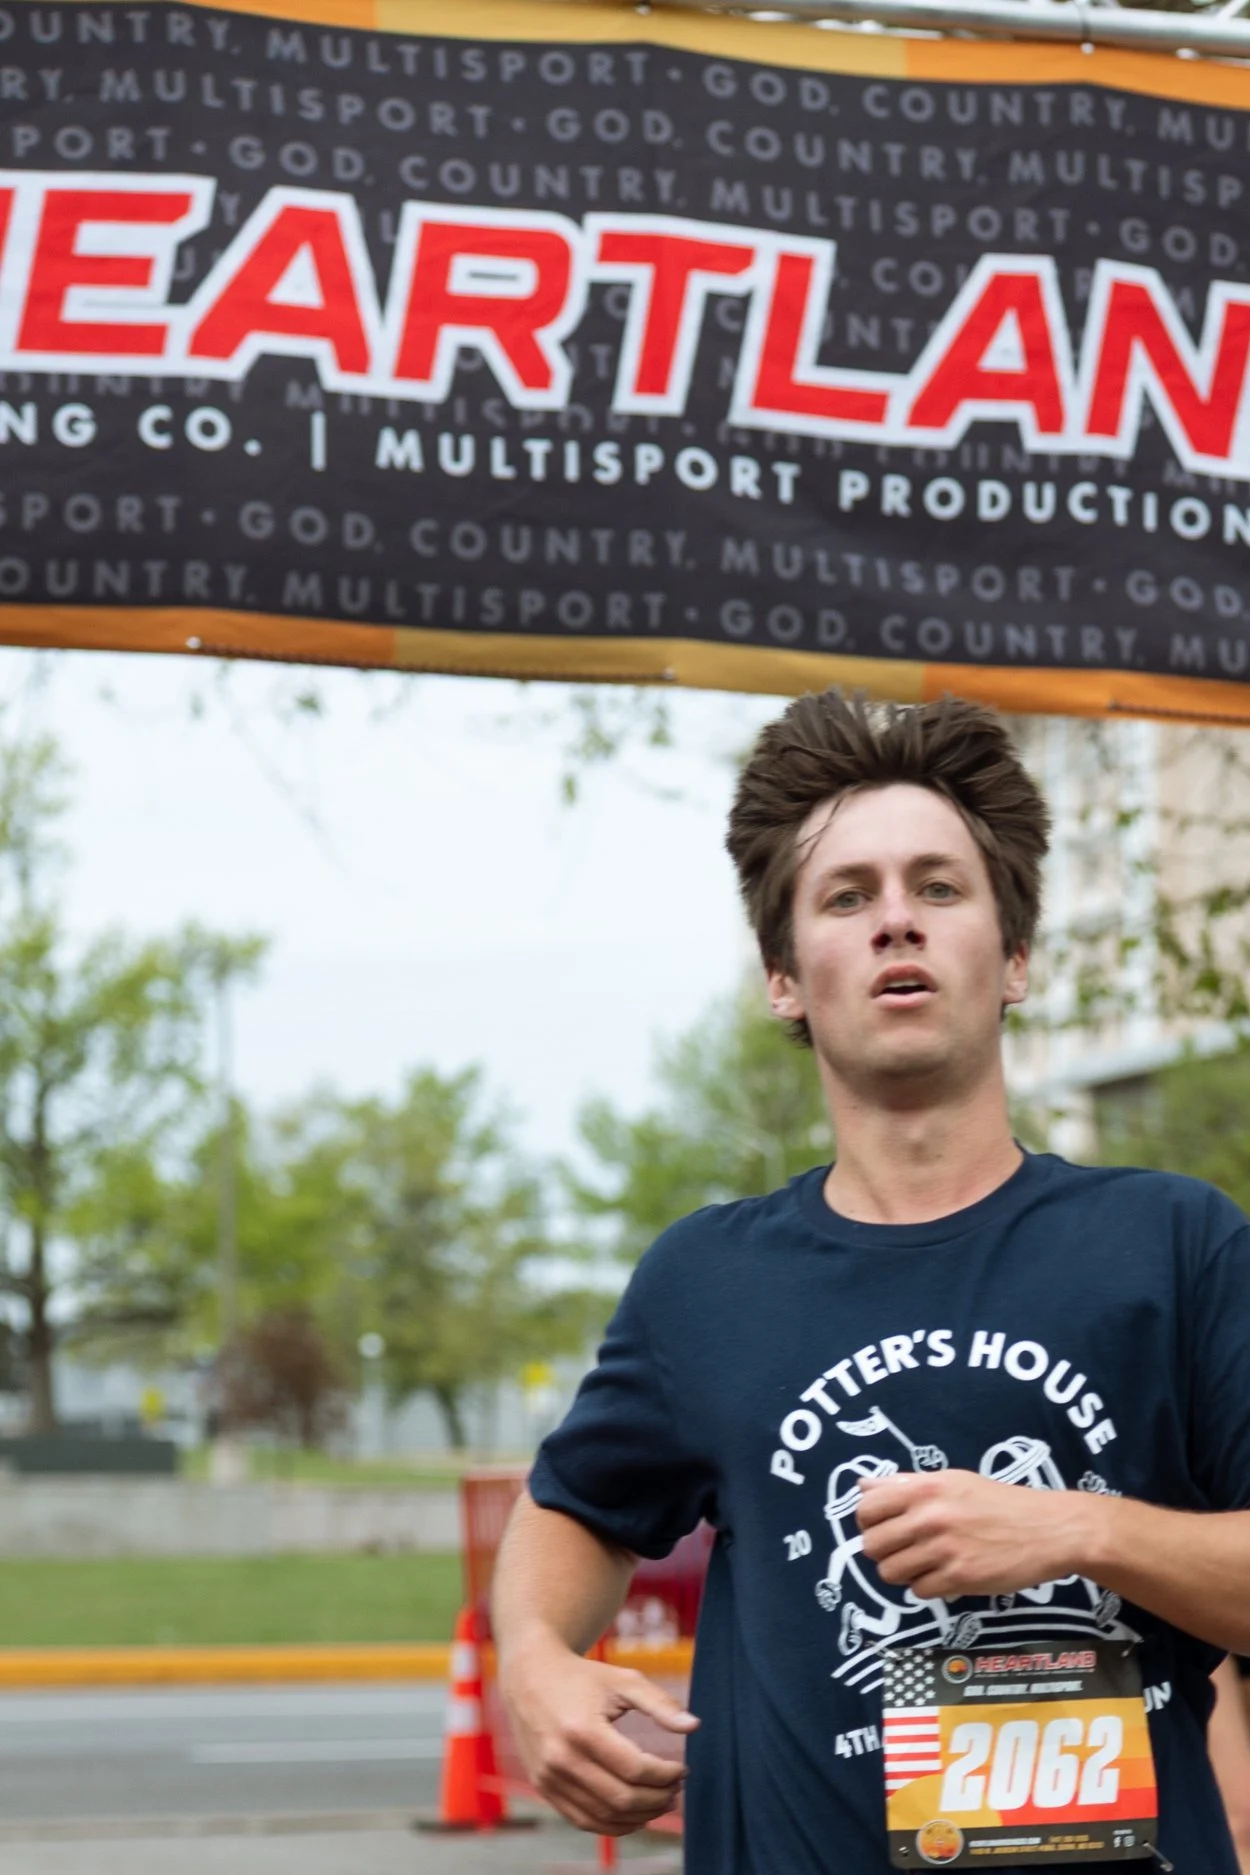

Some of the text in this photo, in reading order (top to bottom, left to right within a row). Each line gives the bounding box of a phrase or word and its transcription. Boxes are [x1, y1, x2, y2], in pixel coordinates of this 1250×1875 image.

[265, 29, 648, 86] MULTISPORT
[98, 68, 493, 139] MULTISPORT
[710, 177, 1071, 244] MULTISPORT
[137, 404, 262, 457] CO.
[375, 426, 800, 501] MULTISPORT
[0, 491, 182, 534] PORT
[721, 537, 1077, 603] MULTISPORT
[282, 571, 667, 627] MULTISPORT
[968, 1332, 1118, 1455] HOUSE
[974, 1650, 1097, 1674] HEARTLAND
[834, 1724, 880, 1759] 4TH
[940, 1715, 1124, 1812] 2062
